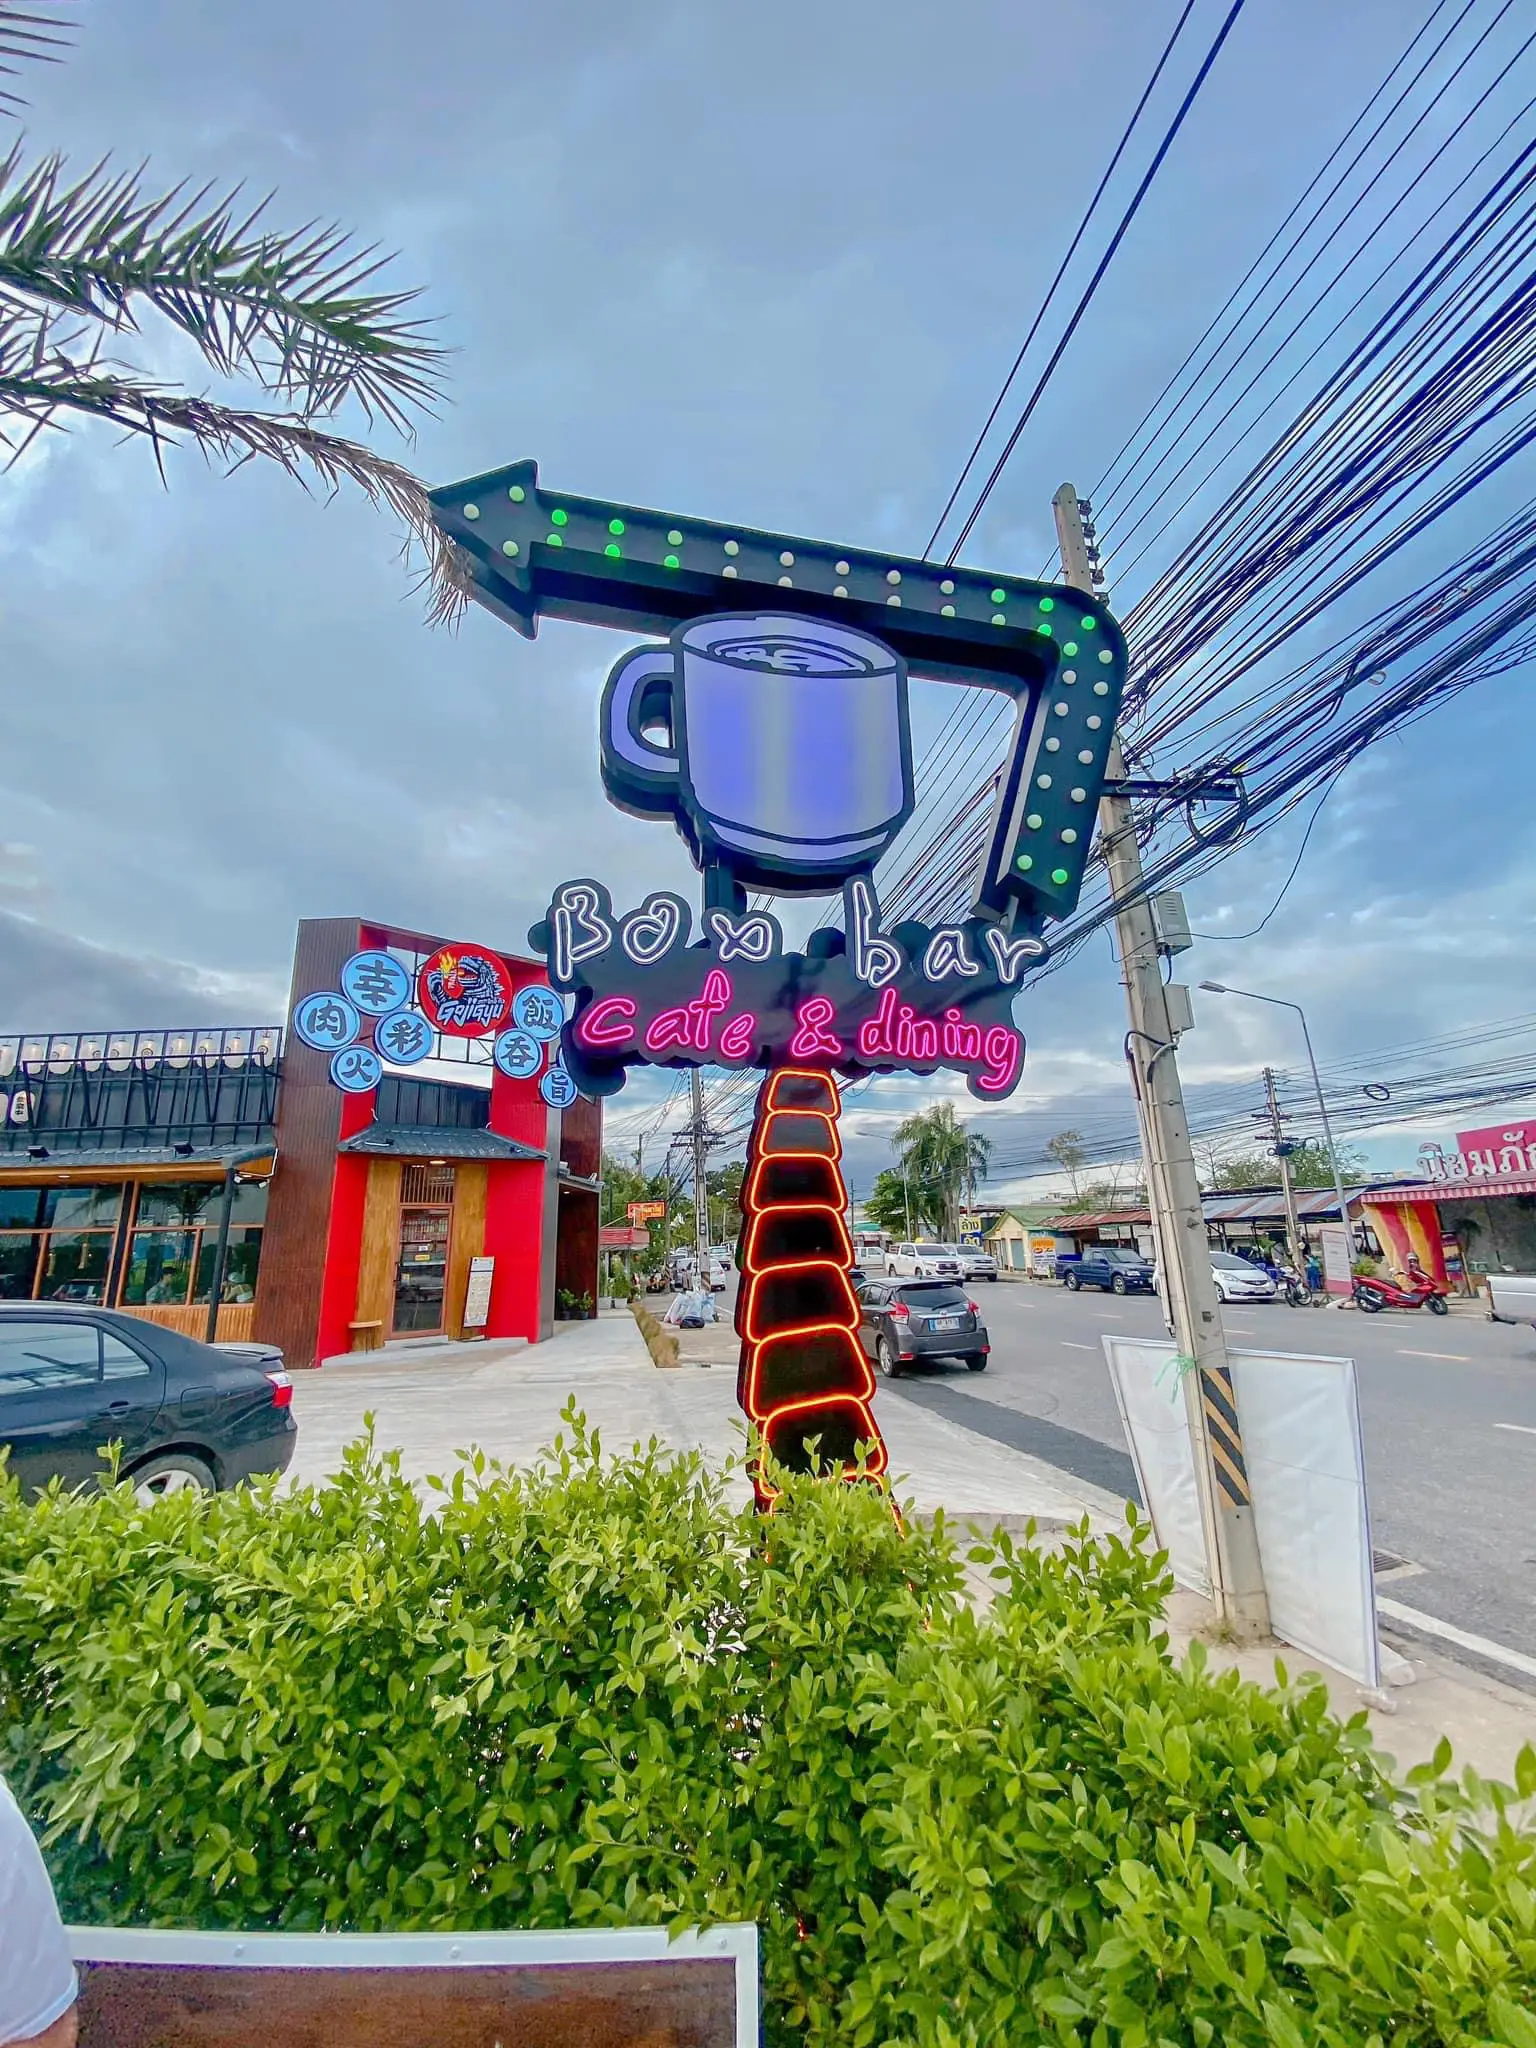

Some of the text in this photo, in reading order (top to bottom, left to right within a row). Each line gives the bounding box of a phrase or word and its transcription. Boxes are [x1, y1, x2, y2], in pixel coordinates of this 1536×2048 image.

[852, 880, 1044, 988] bar
[307, 1000, 347, 1039] 肉
[522, 993, 558, 1032] 飯
[791, 999, 842, 1058] &
[860, 988, 1018, 1090] dining
[341, 1053, 373, 1082] 火
[551, 1073, 569, 1102] 旨
